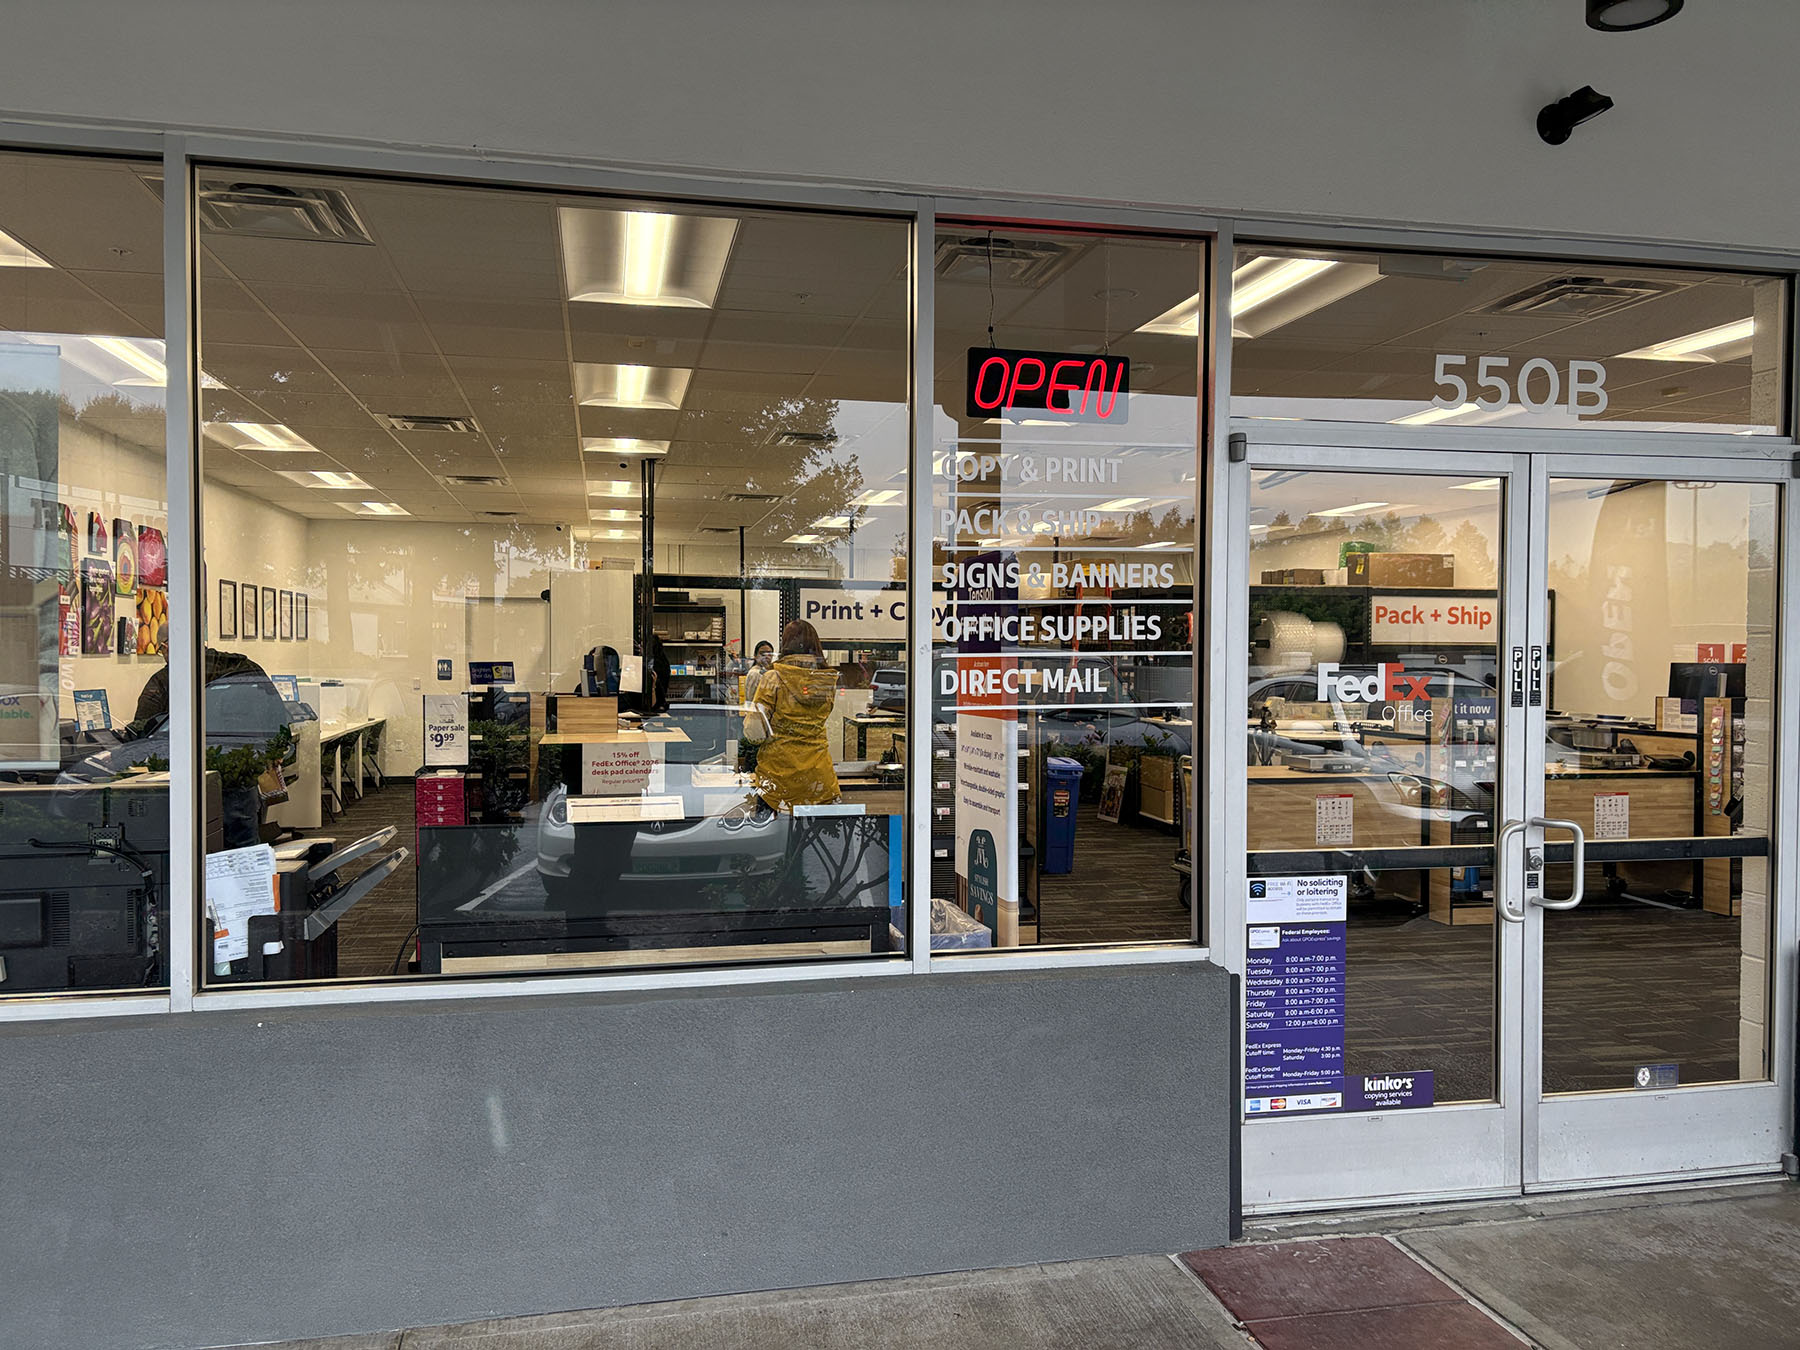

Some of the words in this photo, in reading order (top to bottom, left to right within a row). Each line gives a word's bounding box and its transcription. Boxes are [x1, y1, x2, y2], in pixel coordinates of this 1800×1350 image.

[974, 356, 1124, 419] OPEN
[1431, 354, 1608, 415] 550B
[942, 454, 1014, 482] COPY
[1020, 456, 1040, 482] &
[1046, 457, 1123, 483] PRINT
[939, 509, 1011, 536] PACK
[1016, 509, 1034, 536] &
[1041, 509, 1100, 536] SHIP
[941, 563, 1020, 589] SIGNS
[1027, 562, 1047, 589] &
[1052, 562, 1174, 589] BANNERS
[806, 600, 864, 620] Print
[870, 604, 883, 618] +
[889, 602, 950, 626] Cy
[1375, 605, 1424, 625] Pack
[1430, 609, 1442, 622] +
[1447, 605, 1492, 630] Ship
[941, 615, 1037, 642] OFFICE
[1040, 615, 1162, 641] SUPPLIES
[1709, 647, 1714, 657] 1
[1513, 651, 1522, 692] PULL
[1532, 650, 1540, 691] PULL
[940, 668, 1038, 695] DIRECT
[1042, 668, 1107, 693] MAIL
[1317, 663, 1433, 702] FedEx
[1381, 705, 1434, 722] Office
[1460, 702, 1468, 714] it
[1469, 706, 1491, 714] now
[428, 724, 449, 733] Paper
[610, 768, 624, 776] pad
[1309, 878, 1344, 888] soliciting
[970, 884, 994, 906] SAVINGS
[1306, 888, 1338, 896] loitering
[1246, 957, 1273, 966] Monday
[1246, 968, 1274, 976] Tuesday
[1246, 978, 1283, 986] Wednesday
[1246, 989, 1276, 997] Thursday
[1246, 1000, 1266, 1008] Friday
[1246, 1010, 1275, 1018] Saturday
[1246, 1021, 1270, 1030] Sunday
[1364, 1076, 1413, 1092] kinko's
